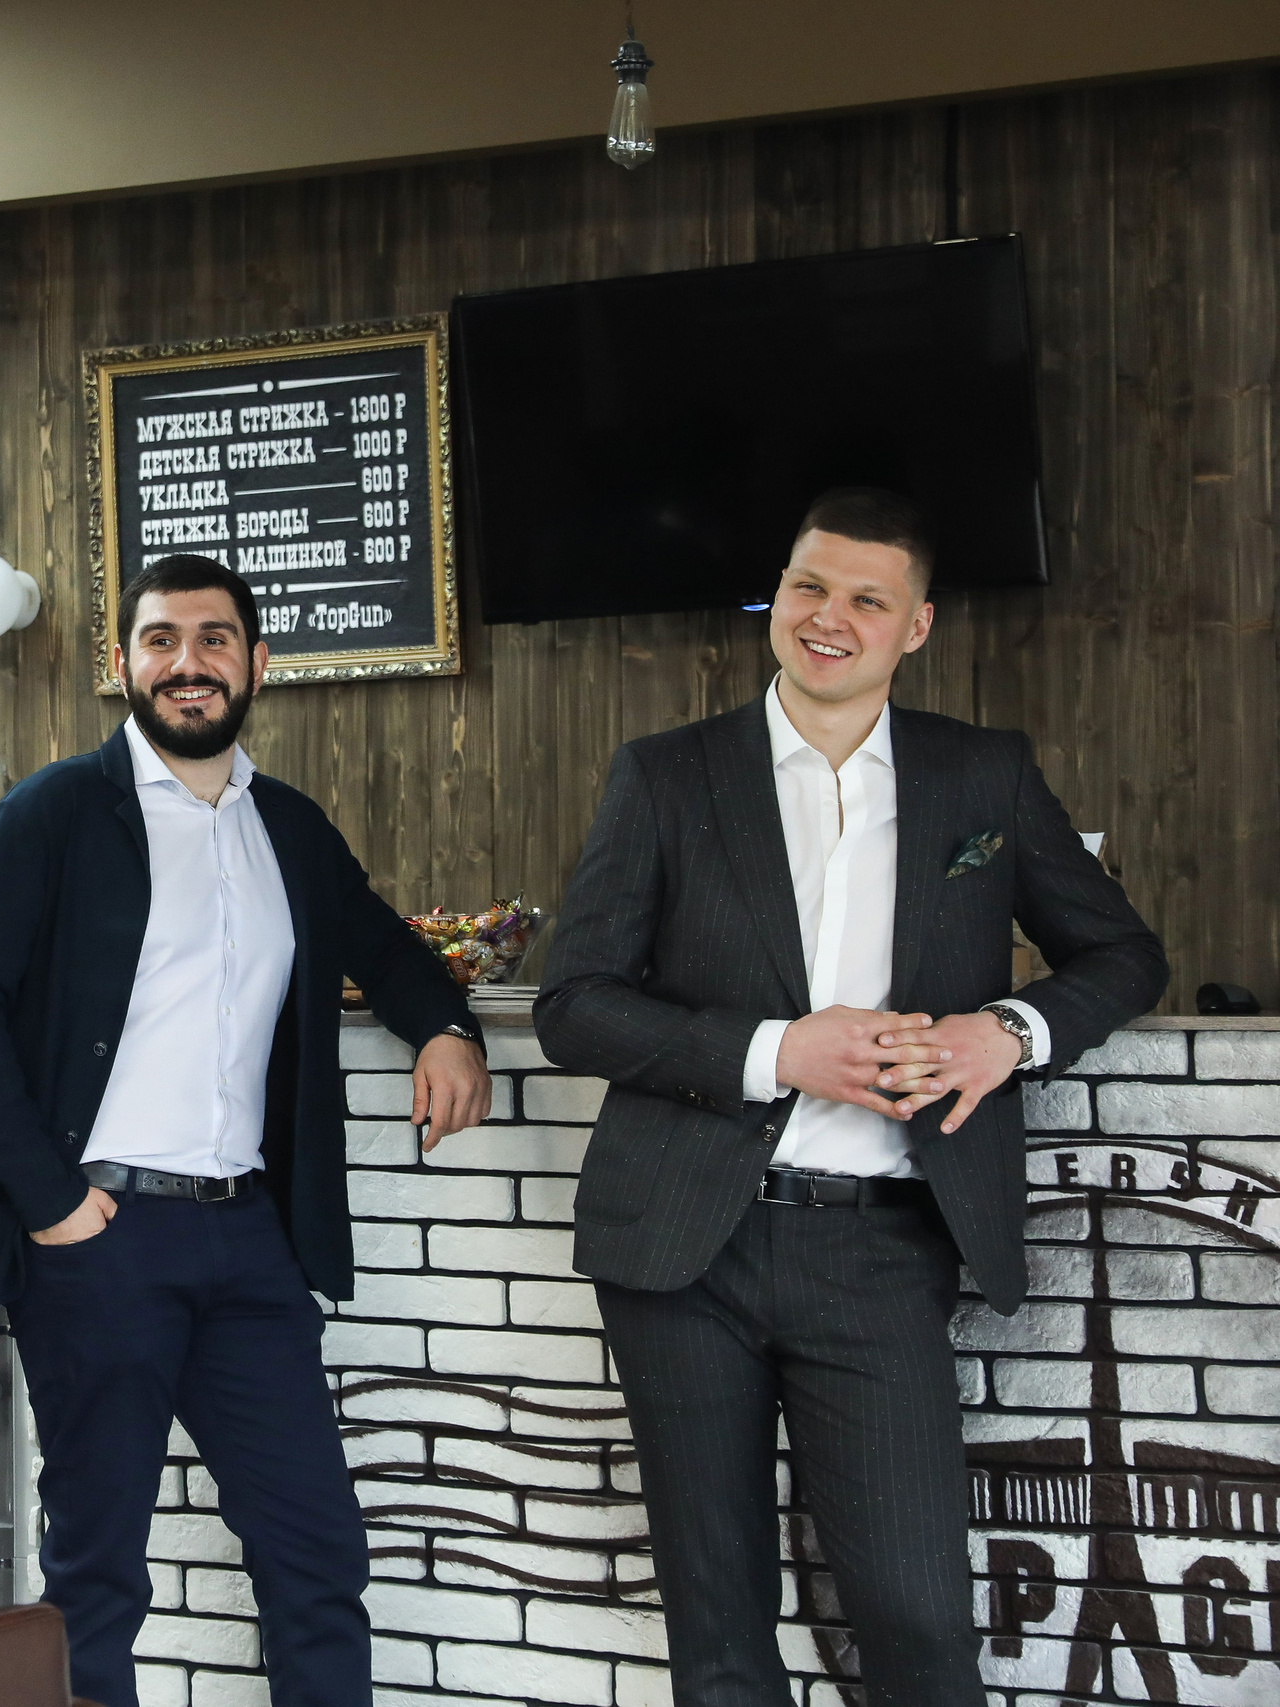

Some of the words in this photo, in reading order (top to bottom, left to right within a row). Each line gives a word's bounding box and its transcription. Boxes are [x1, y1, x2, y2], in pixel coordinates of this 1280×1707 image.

[137, 409, 233, 443] МУЖСКАЯ
[240, 401, 329, 433] СТРИЖКА
[351, 395, 389, 423] 1300
[139, 446, 220, 480] ДЕТСКАЯ
[227, 437, 316, 469] СТРИЖКА
[354, 430, 391, 458] 1000
[139, 480, 229, 511] УКЛАДКА
[362, 465, 392, 493] 600
[141, 514, 230, 546] СТРИЖКА
[236, 508, 309, 538] БОРОДЫ
[363, 501, 393, 528] 600
[237, 540, 346, 573] МАШИНКОЙ
[364, 536, 394, 564] 600
[257, 605, 300, 634] 1987
[986, 1531, 1280, 1707] PAG
